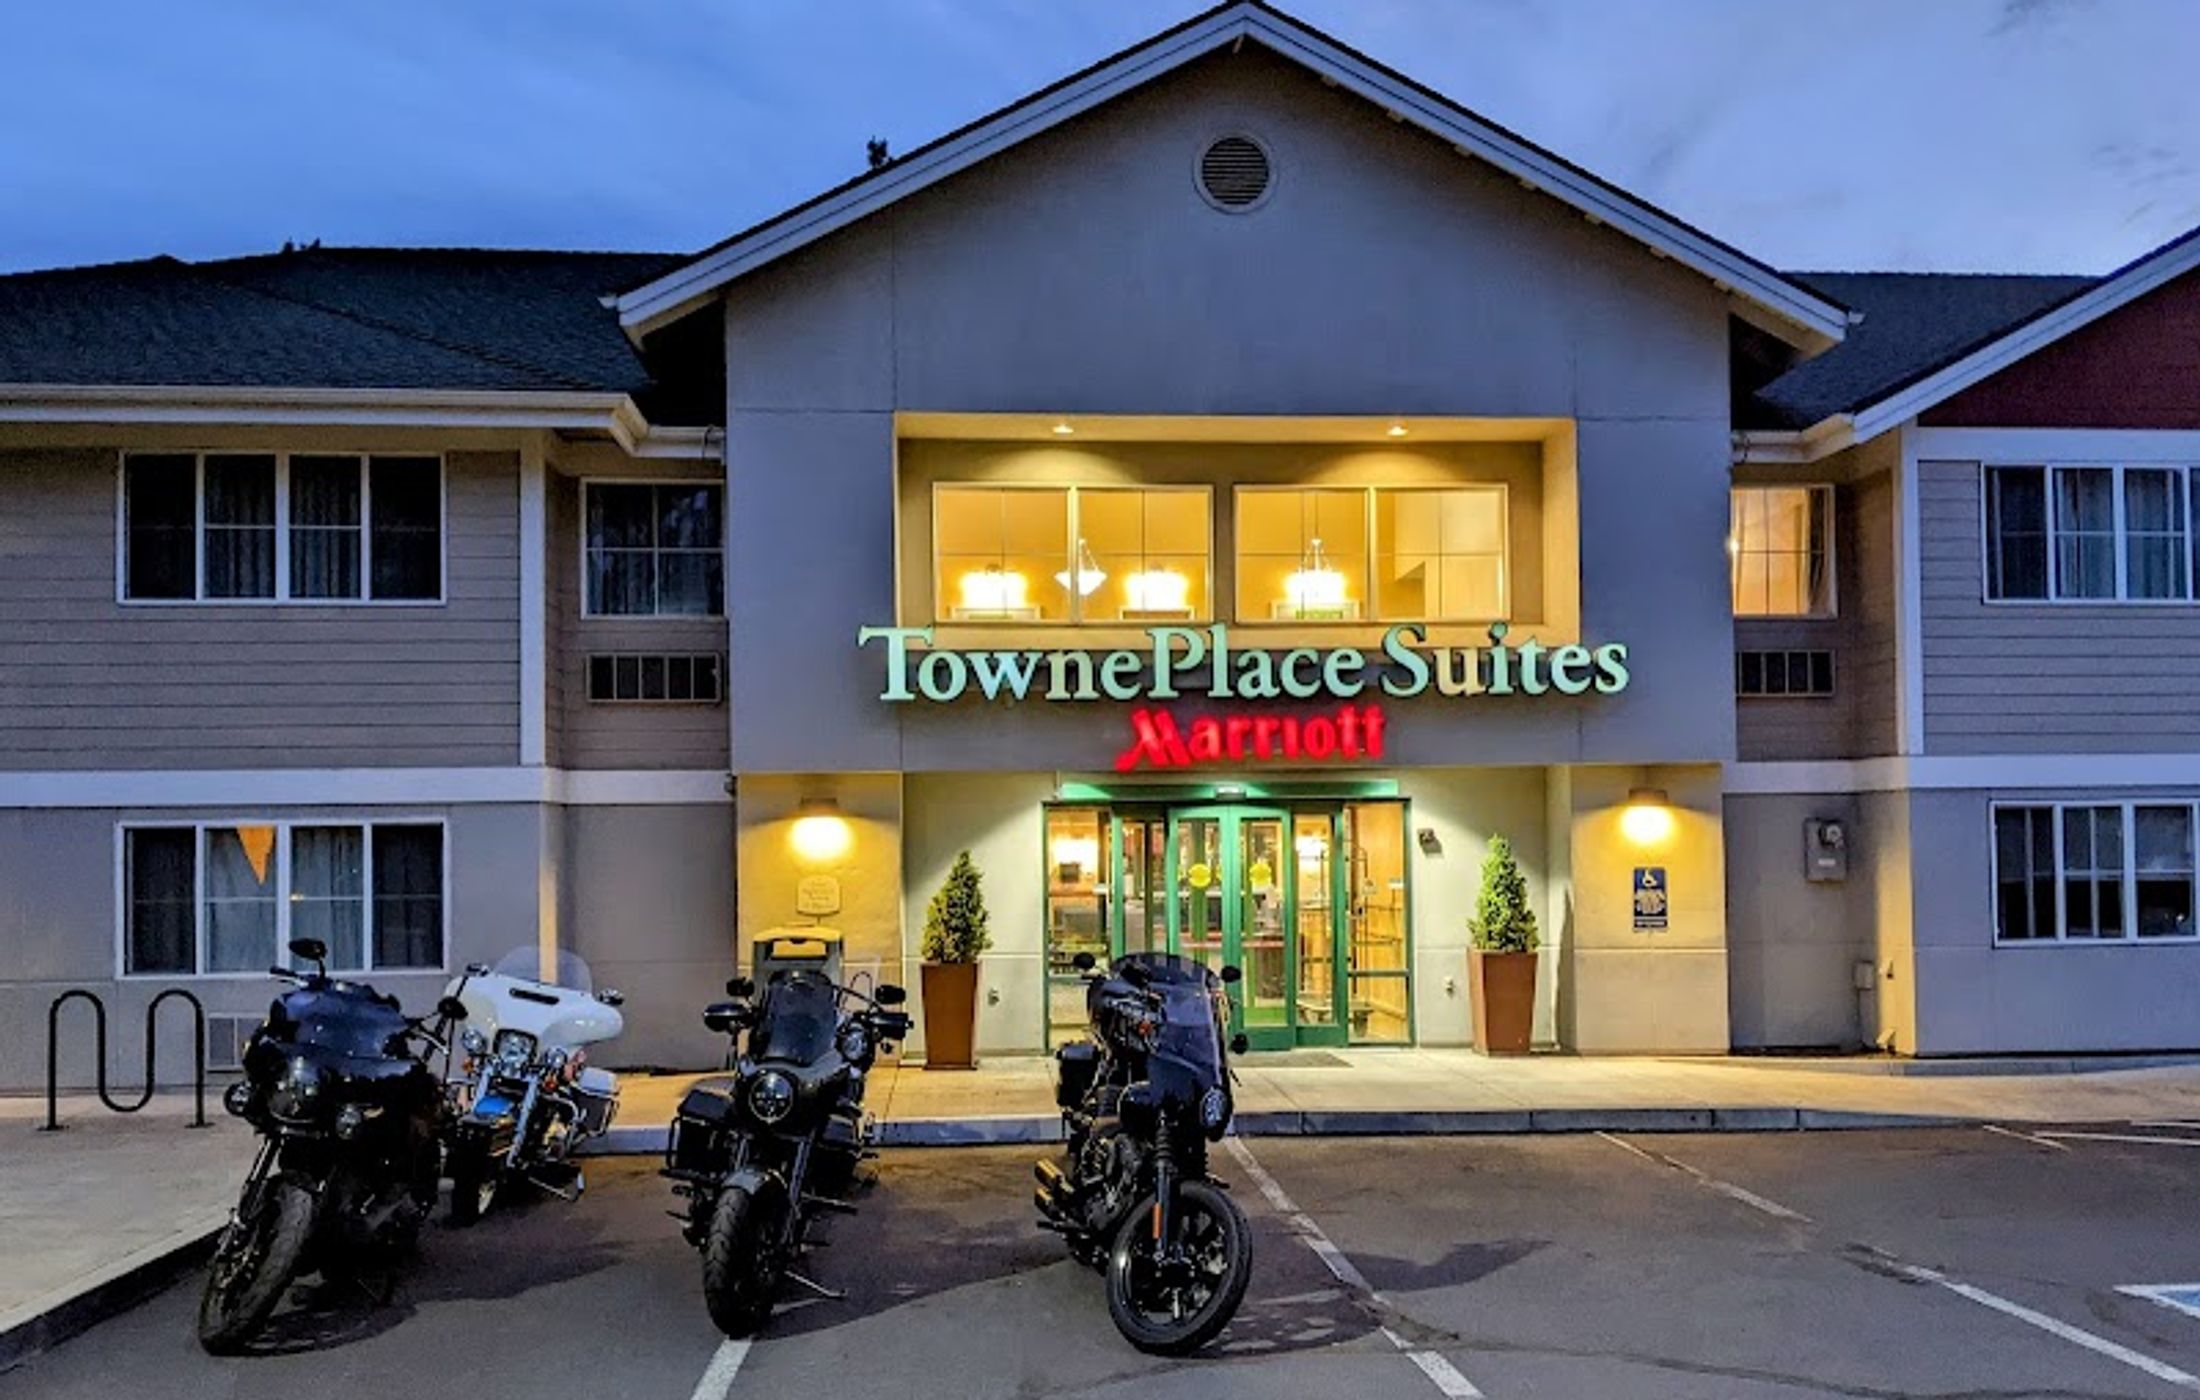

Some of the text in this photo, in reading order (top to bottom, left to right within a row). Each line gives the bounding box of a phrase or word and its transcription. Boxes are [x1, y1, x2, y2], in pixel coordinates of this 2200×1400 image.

[858, 622, 1630, 702] TownePlace Suites
[1115, 705, 1386, 771] Marriott
